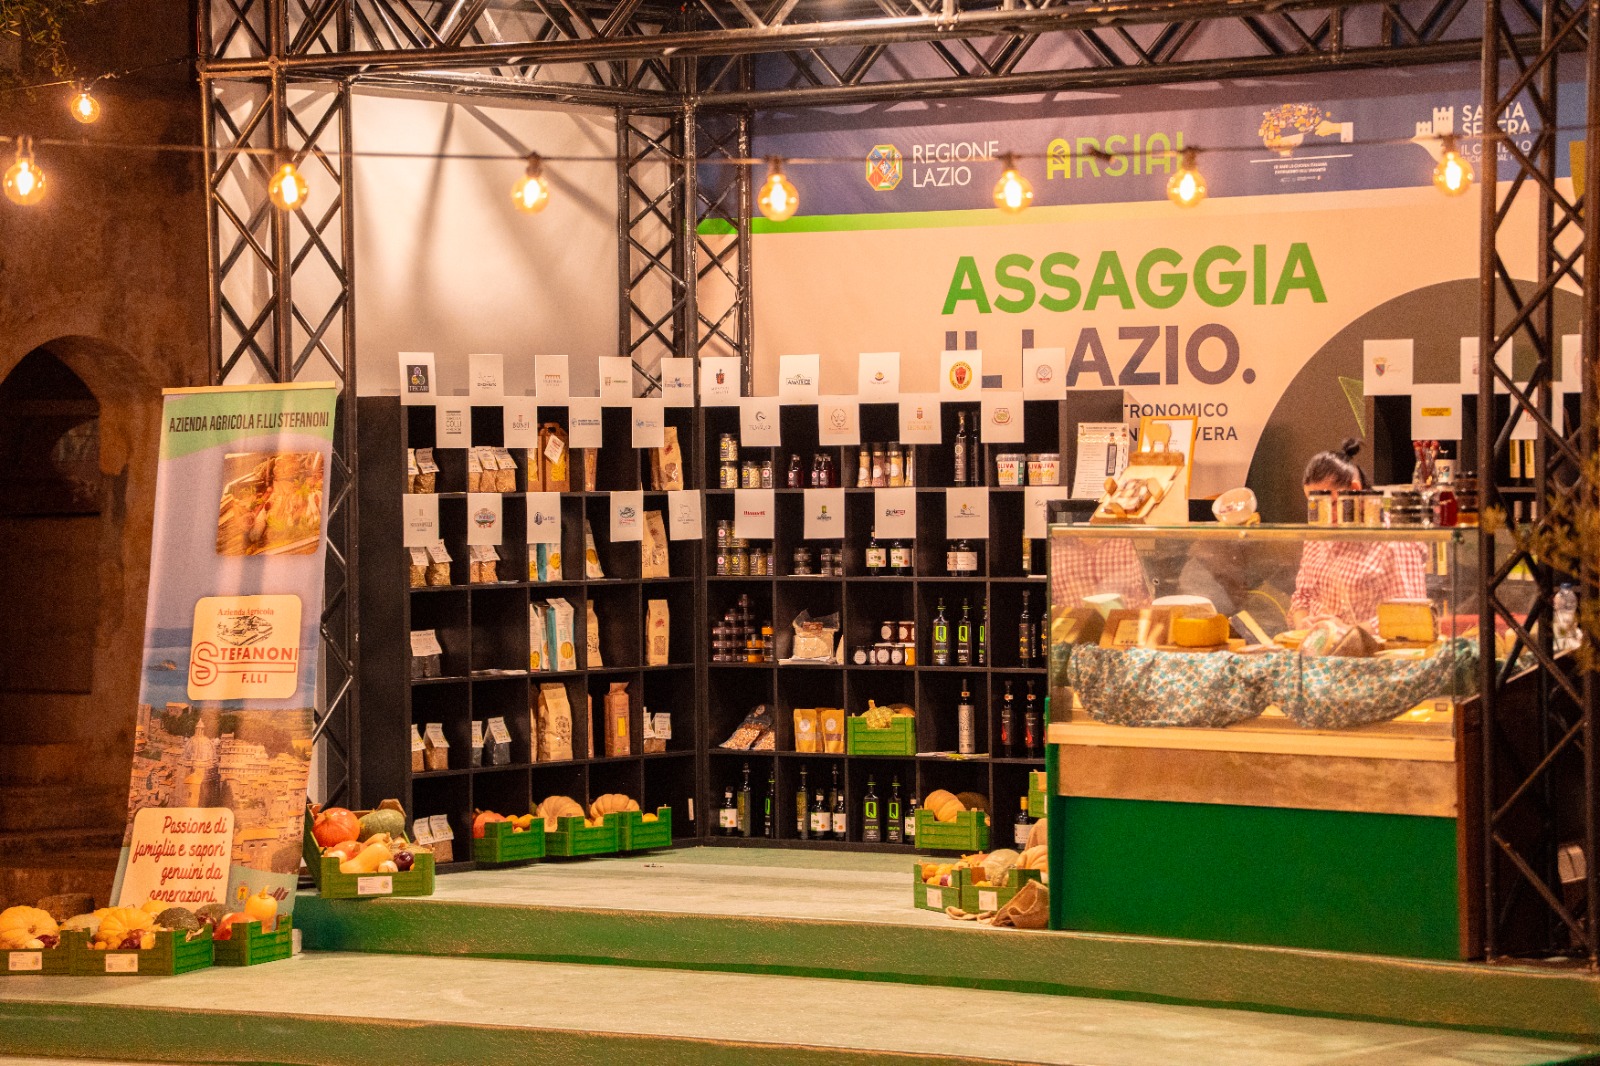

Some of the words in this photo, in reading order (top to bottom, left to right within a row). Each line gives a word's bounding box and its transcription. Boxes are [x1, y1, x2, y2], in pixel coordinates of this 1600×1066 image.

[912, 140, 999, 164] REGIONE
[912, 166, 972, 188] LAZIO
[941, 242, 1328, 315] ASSAGGIA
[1123, 402, 1229, 418] RONOMICO
[169, 416, 207, 432] AZIENDA
[209, 414, 254, 431] AGRICOLA
[256, 413, 277, 429] F.LLI
[278, 412, 329, 428] STEFANONI
[217, 608, 246, 616] Azienda
[242, 673, 268, 684] F.LLI
[162, 815, 212, 834] Passione
[213, 815, 228, 834] di
[133, 838, 176, 863] famiglia
[178, 844, 186, 855] e
[189, 841, 226, 862] sapori
[160, 863, 204, 885] genuini
[205, 863, 223, 880] da
